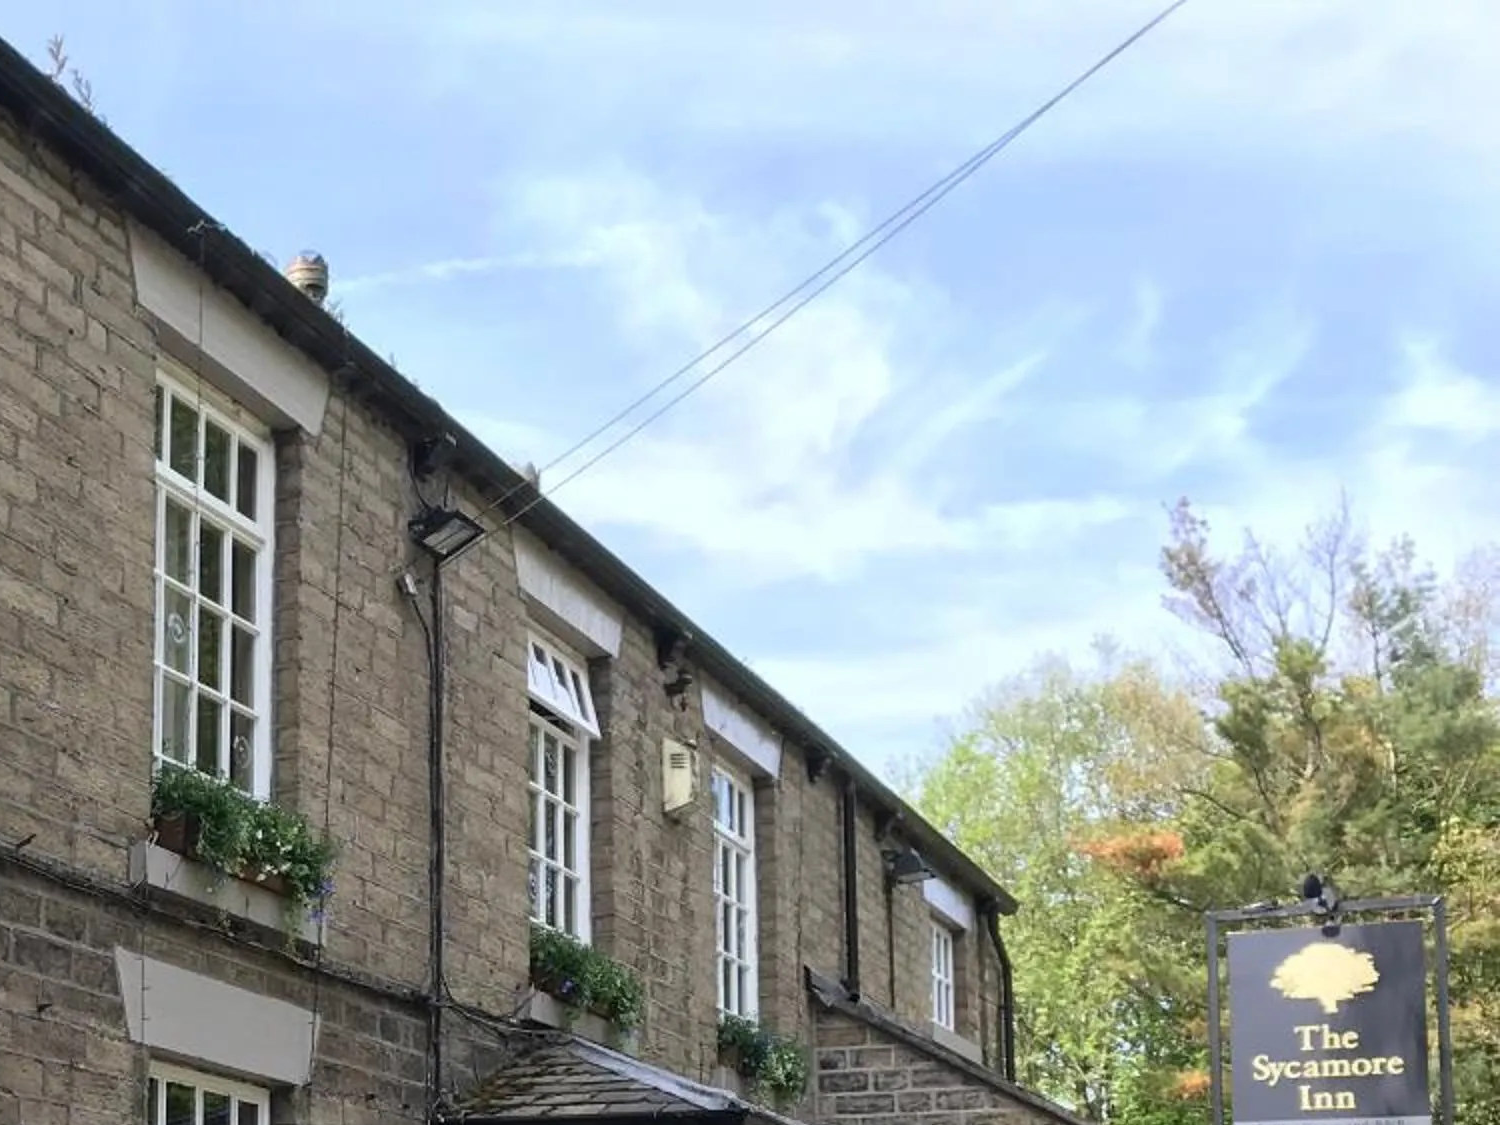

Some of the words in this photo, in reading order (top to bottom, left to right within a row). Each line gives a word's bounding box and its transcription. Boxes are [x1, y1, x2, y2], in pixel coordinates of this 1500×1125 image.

[1293, 1023, 1360, 1051] The
[1252, 1053, 1405, 1087] Sycamore
[1298, 1084, 1357, 1111] Inn
